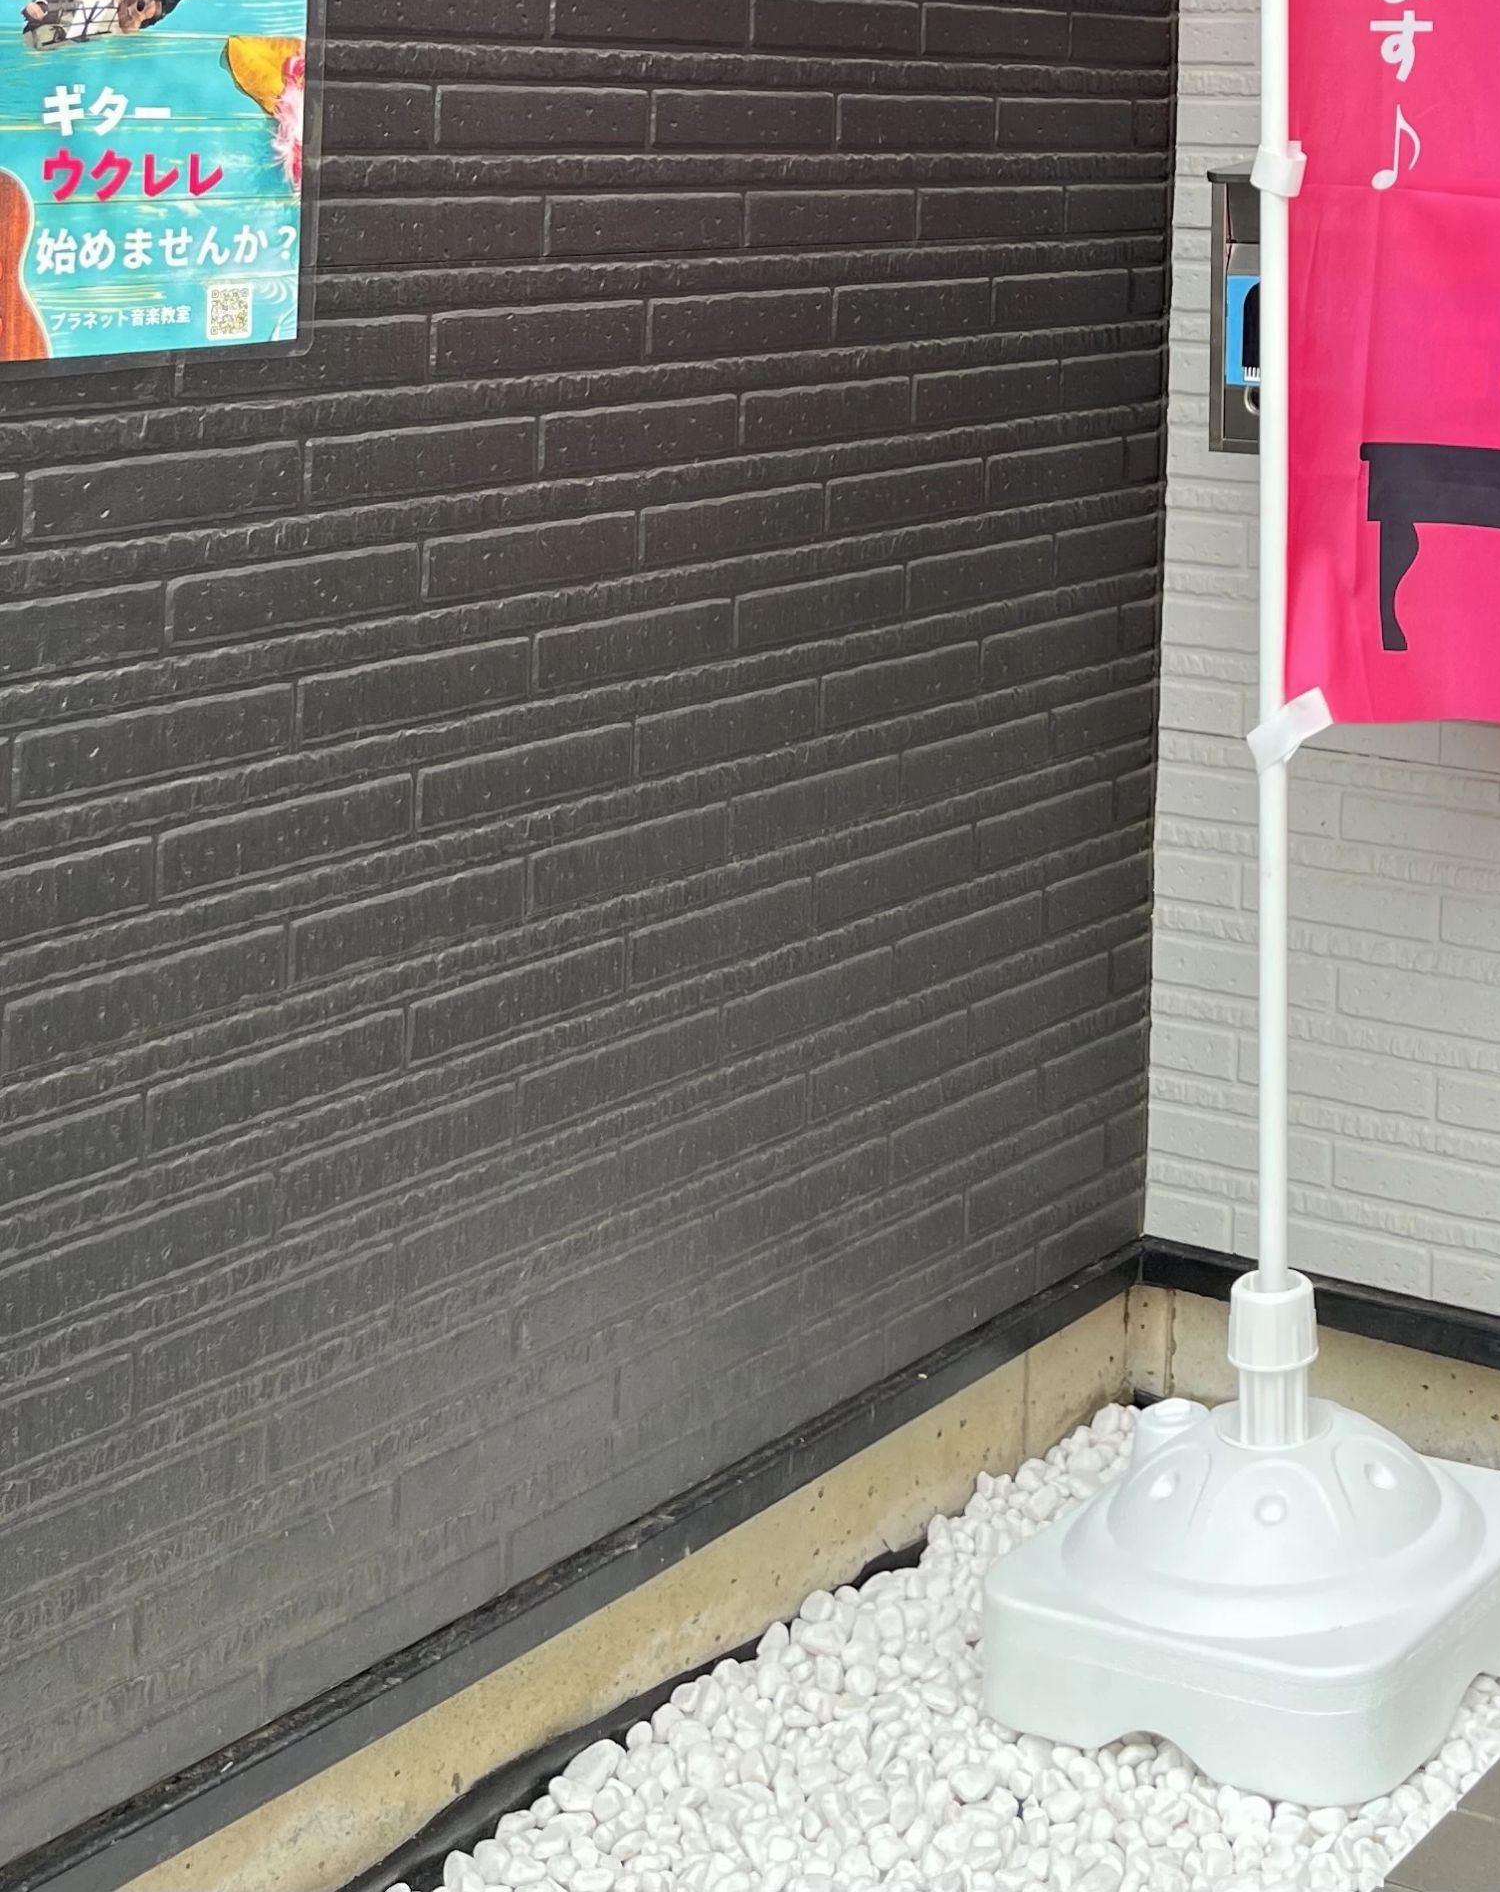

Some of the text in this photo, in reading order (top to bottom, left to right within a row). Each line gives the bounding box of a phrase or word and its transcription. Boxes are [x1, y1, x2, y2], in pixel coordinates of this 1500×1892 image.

[42, 84, 172, 136] ギター
[42, 146, 223, 202] ウクレレ
